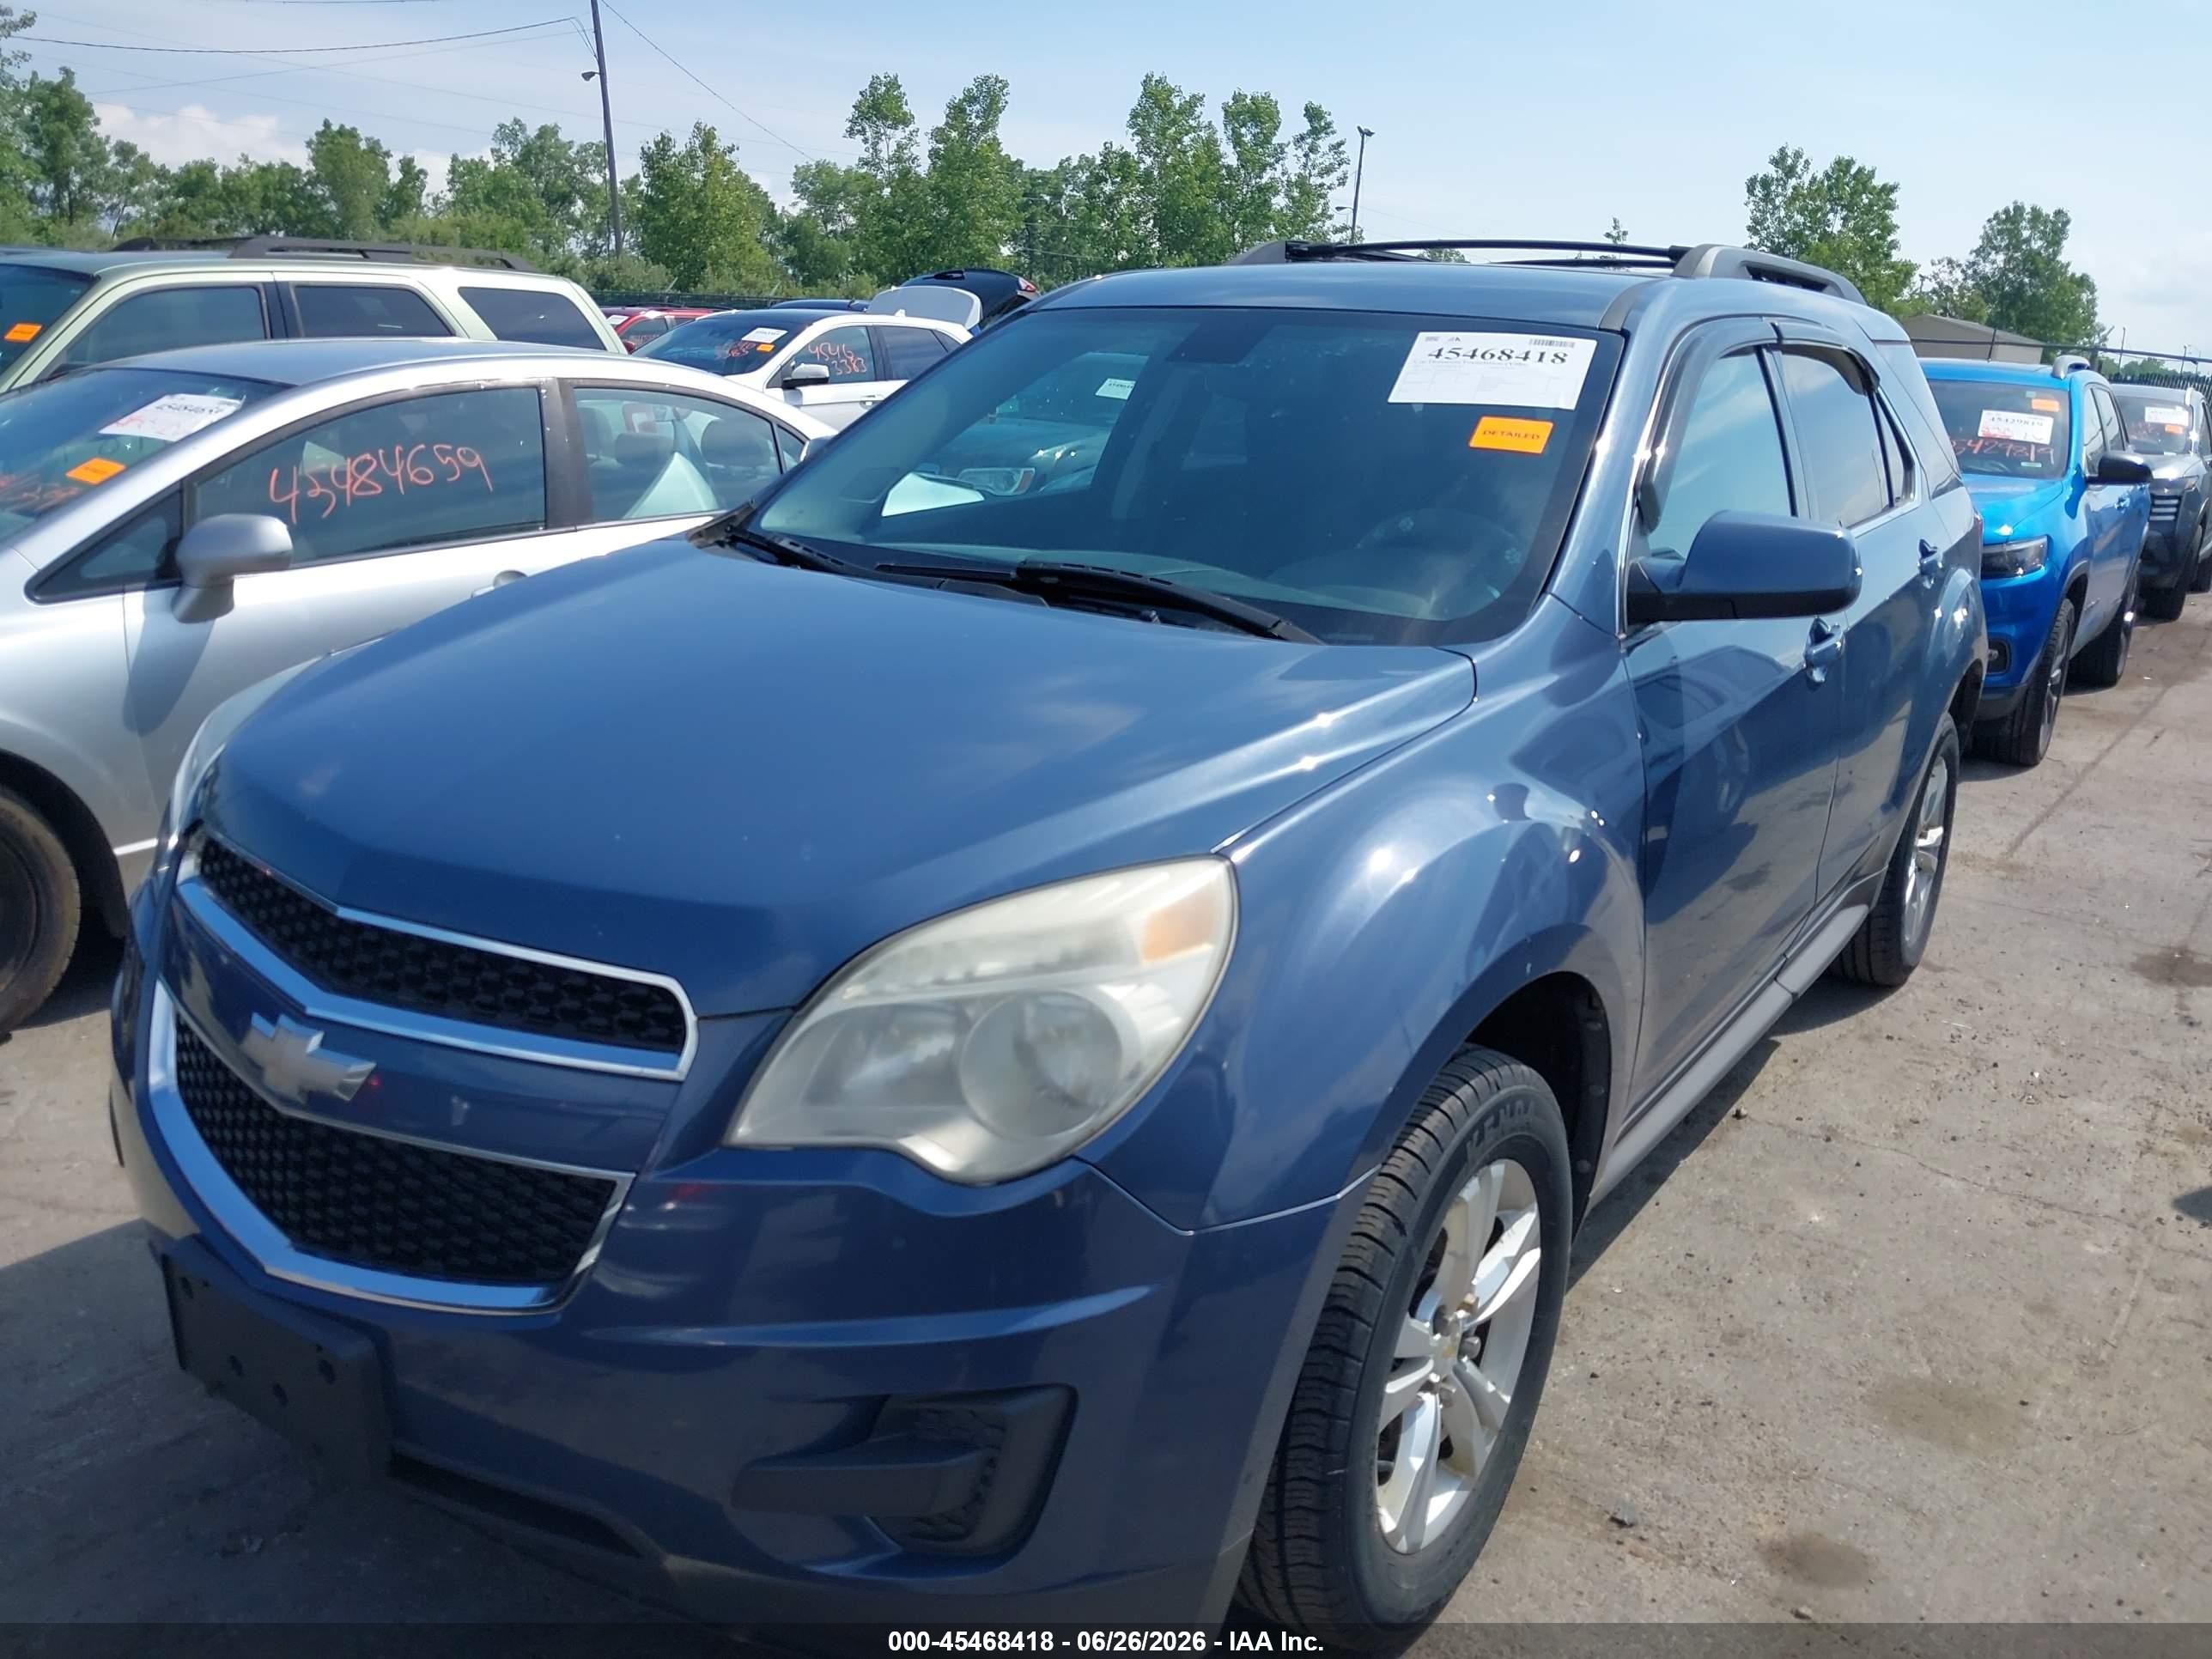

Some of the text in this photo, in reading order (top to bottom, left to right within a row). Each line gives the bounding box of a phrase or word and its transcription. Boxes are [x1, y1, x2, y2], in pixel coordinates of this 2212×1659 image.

[1428, 347, 1568, 365] 45468418
[831, 357, 866, 375] 3383
[1483, 429, 1540, 441] DETAILED
[269, 444, 494, 524] 45484659
